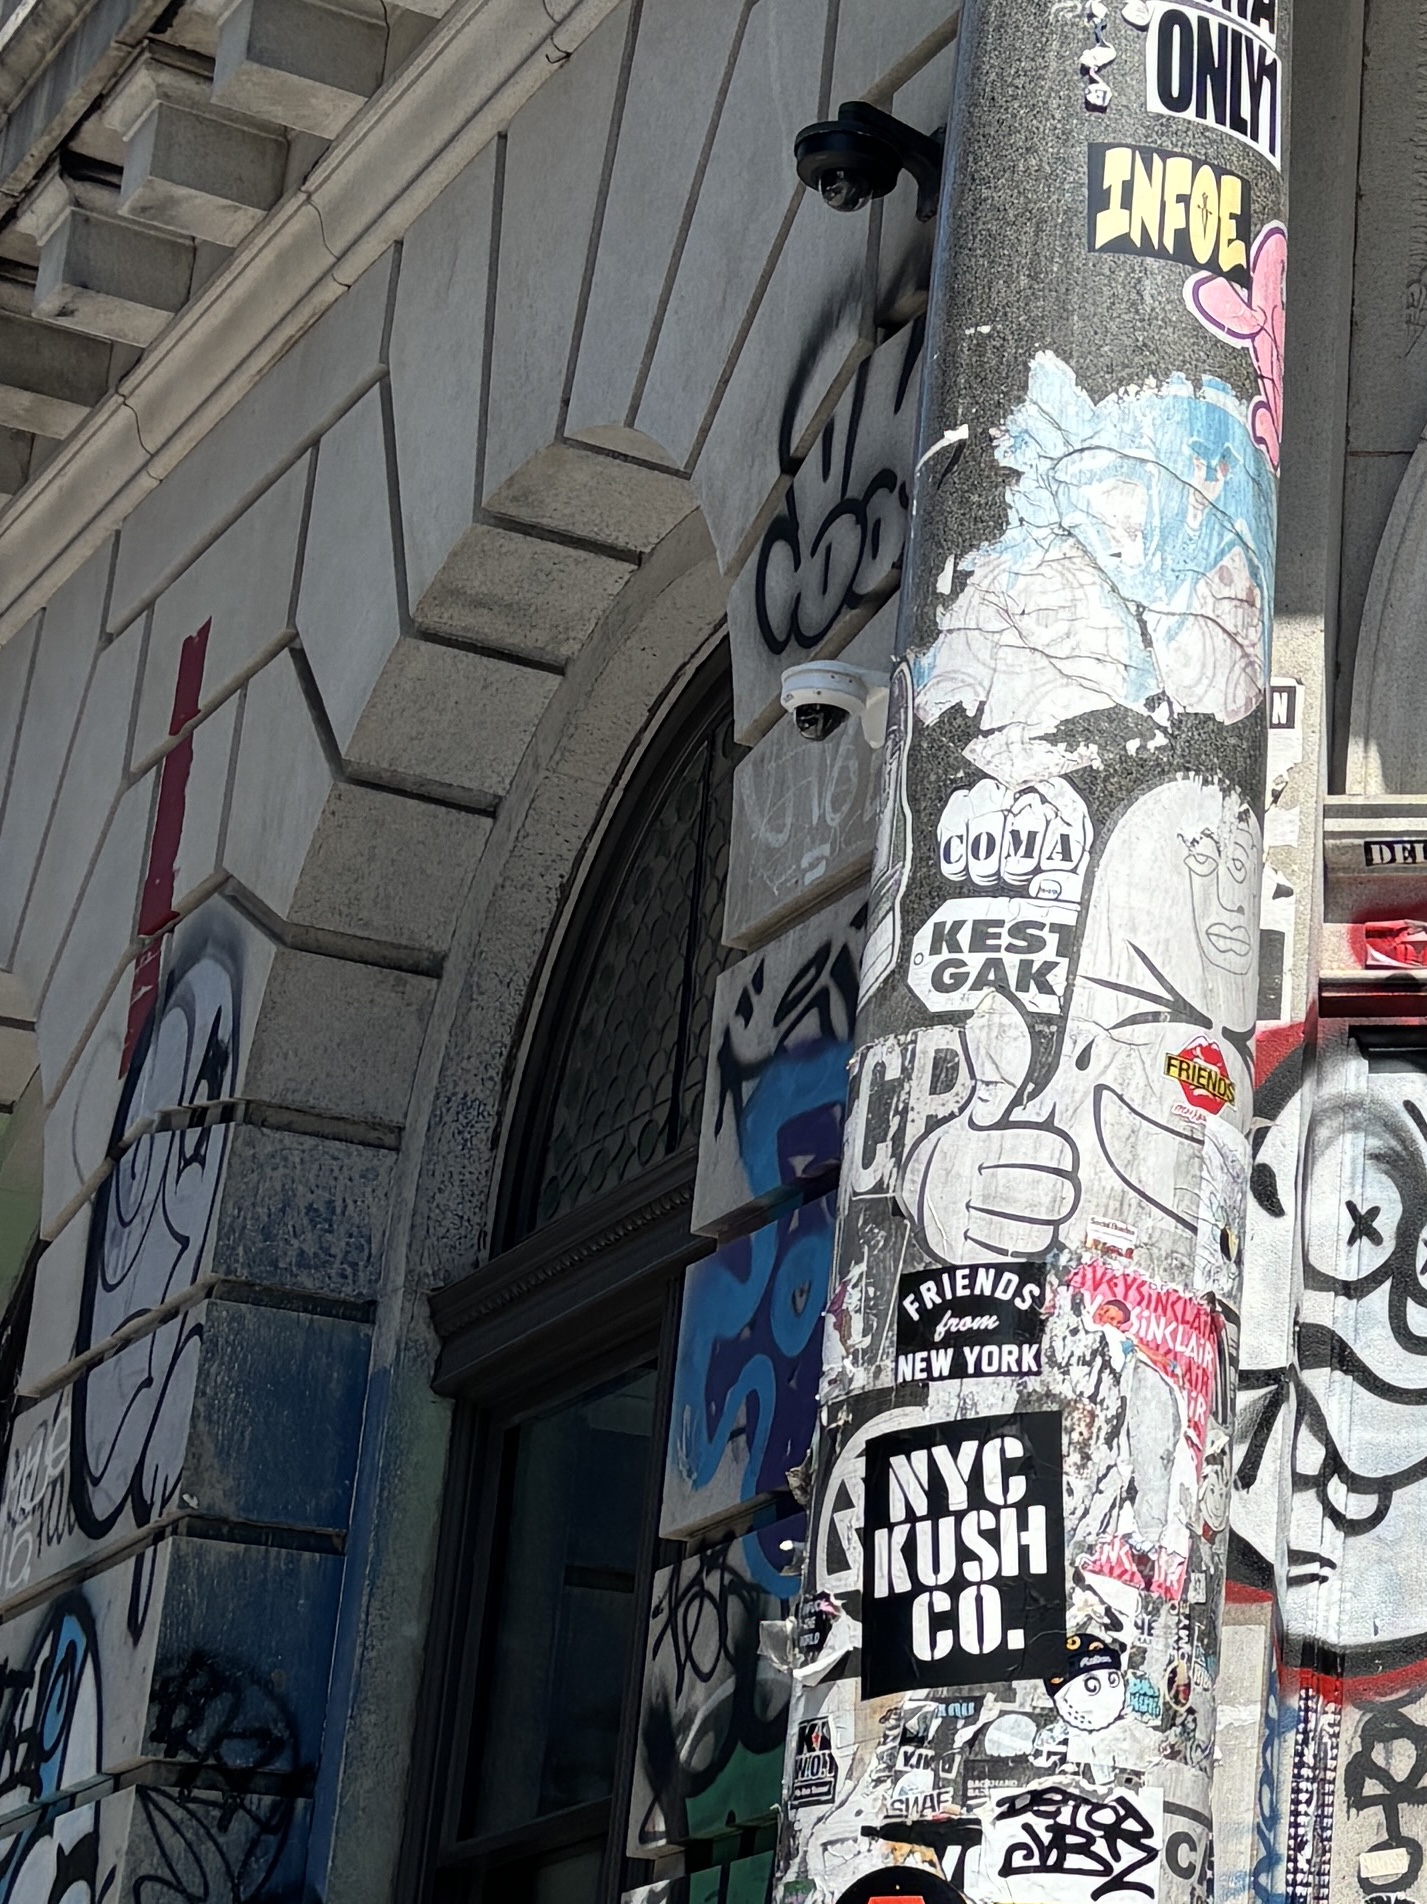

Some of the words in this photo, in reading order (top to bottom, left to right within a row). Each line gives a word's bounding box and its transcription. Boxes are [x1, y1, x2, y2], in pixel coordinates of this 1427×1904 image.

[942, 828, 1074, 865] COMA
[928, 918, 1076, 958] KEST
[930, 957, 1062, 996] GAK
[1166, 1055, 1235, 1104] FRIENDS
[903, 1266, 1041, 1322] FRIENDS
[934, 1314, 1000, 1343] from
[897, 1347, 961, 1384] NEW
[963, 1343, 1040, 1375] YORK
[888, 1435, 1028, 1524] NYC
[873, 1504, 1048, 1599] KUSH
[912, 1583, 1025, 1662] CO.
